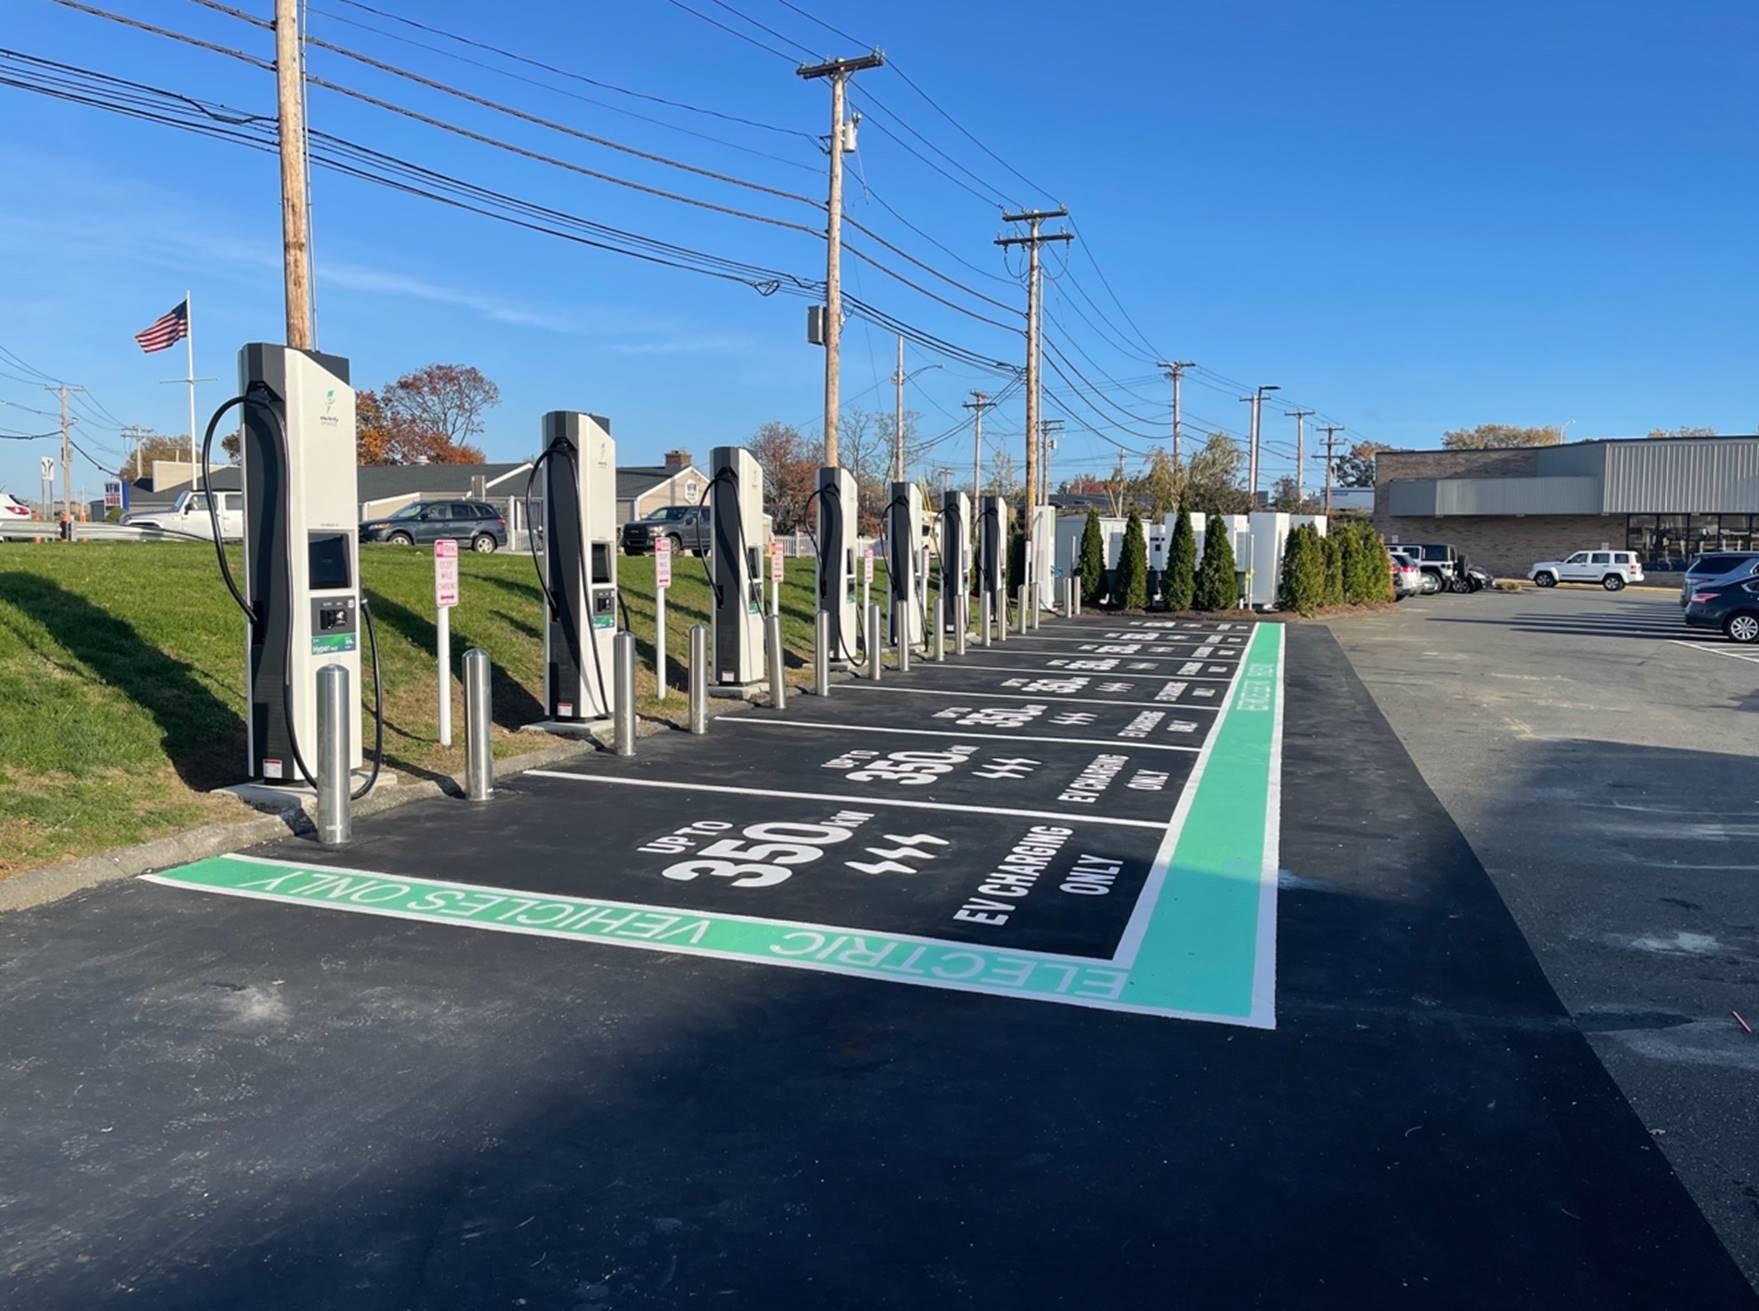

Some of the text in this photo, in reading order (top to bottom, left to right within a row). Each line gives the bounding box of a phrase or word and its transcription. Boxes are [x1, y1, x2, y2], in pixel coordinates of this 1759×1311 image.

[1057, 789, 1100, 803] EV
[636, 820, 734, 855] UP TO
[953, 825, 1073, 926] EV CHARGING
[1059, 854, 1124, 896] ONLY
[235, 871, 1130, 1000] ELECTRIC VEHICLES ONLY
